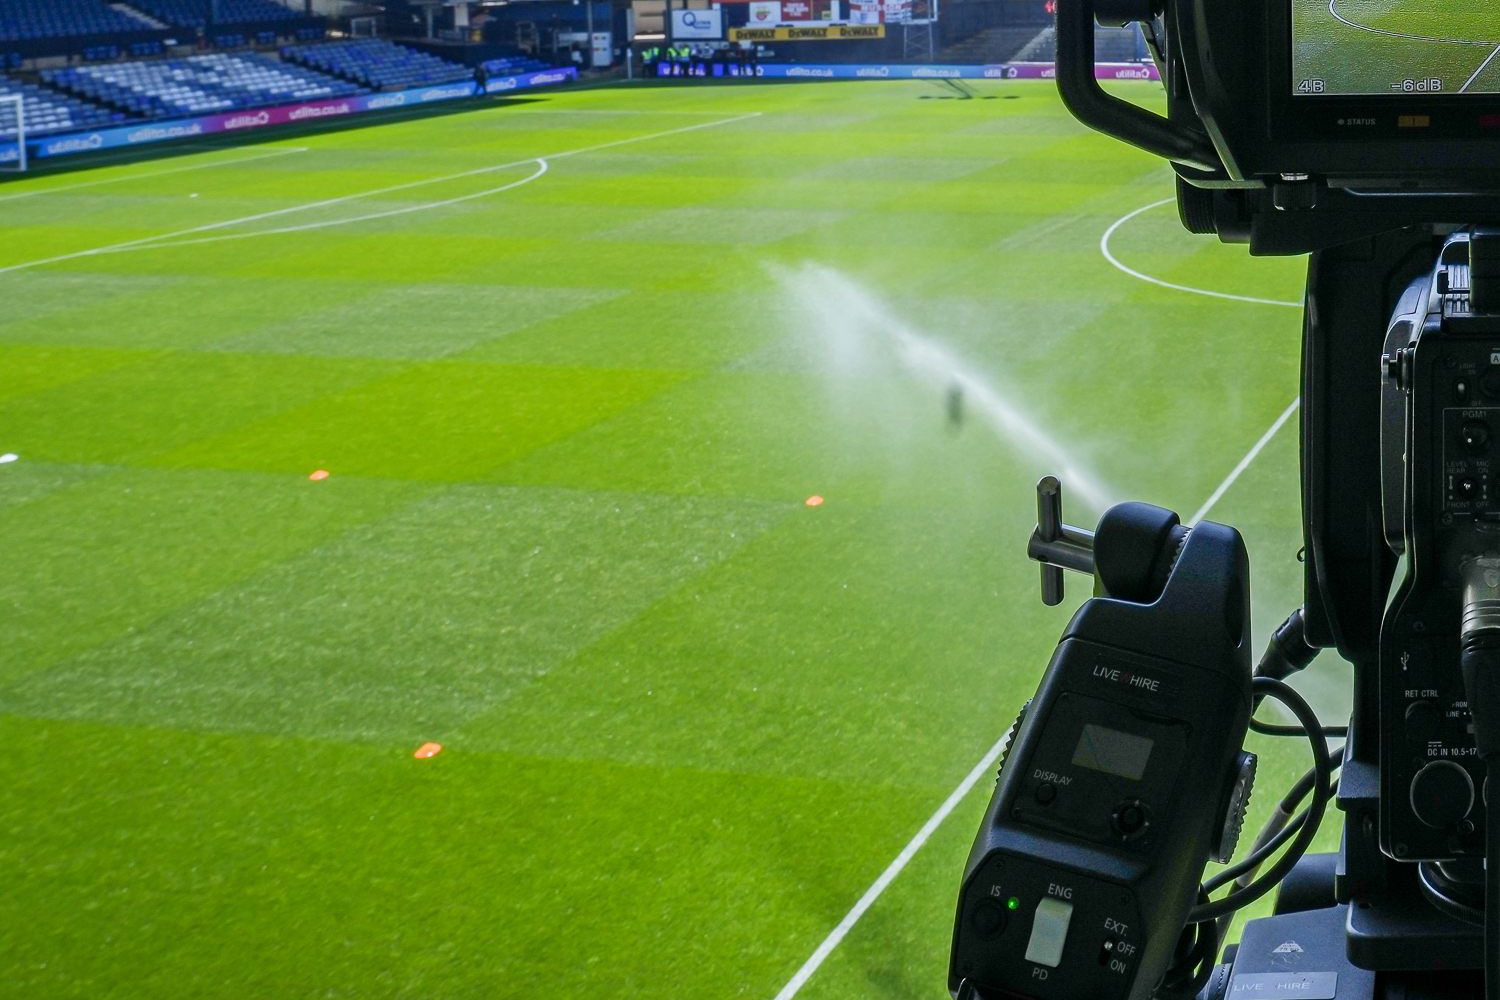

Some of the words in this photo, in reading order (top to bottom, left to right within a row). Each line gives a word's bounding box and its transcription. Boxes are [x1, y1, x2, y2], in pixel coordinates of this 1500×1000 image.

[785, 67, 834, 77] utilita.co.uk
[912, 67, 961, 78] utilita.co.uk
[1298, 79, 1325, 93] 4B
[1391, 78, 1443, 92] -6dB
[1346, 118, 1376, 126] STATUS
[1462, 410, 1487, 418] PGM1
[1093, 665, 1121, 681] LIVE
[1129, 675, 1160, 692] HIRE
[1405, 690, 1418, 698] RET
[1427, 748, 1438, 756] DC
[1440, 748, 1448, 756] IN
[1033, 769, 1073, 785] DISPLAY
[990, 884, 1002, 897] IS
[1048, 883, 1073, 899] ENG
[1104, 917, 1128, 937] EXT.
[1117, 941, 1136, 956] OFF
[1110, 959, 1127, 974] ON
[1032, 967, 1048, 981] PD
[1233, 983, 1264, 991] LIVE
[1277, 982, 1311, 990] HIRE
